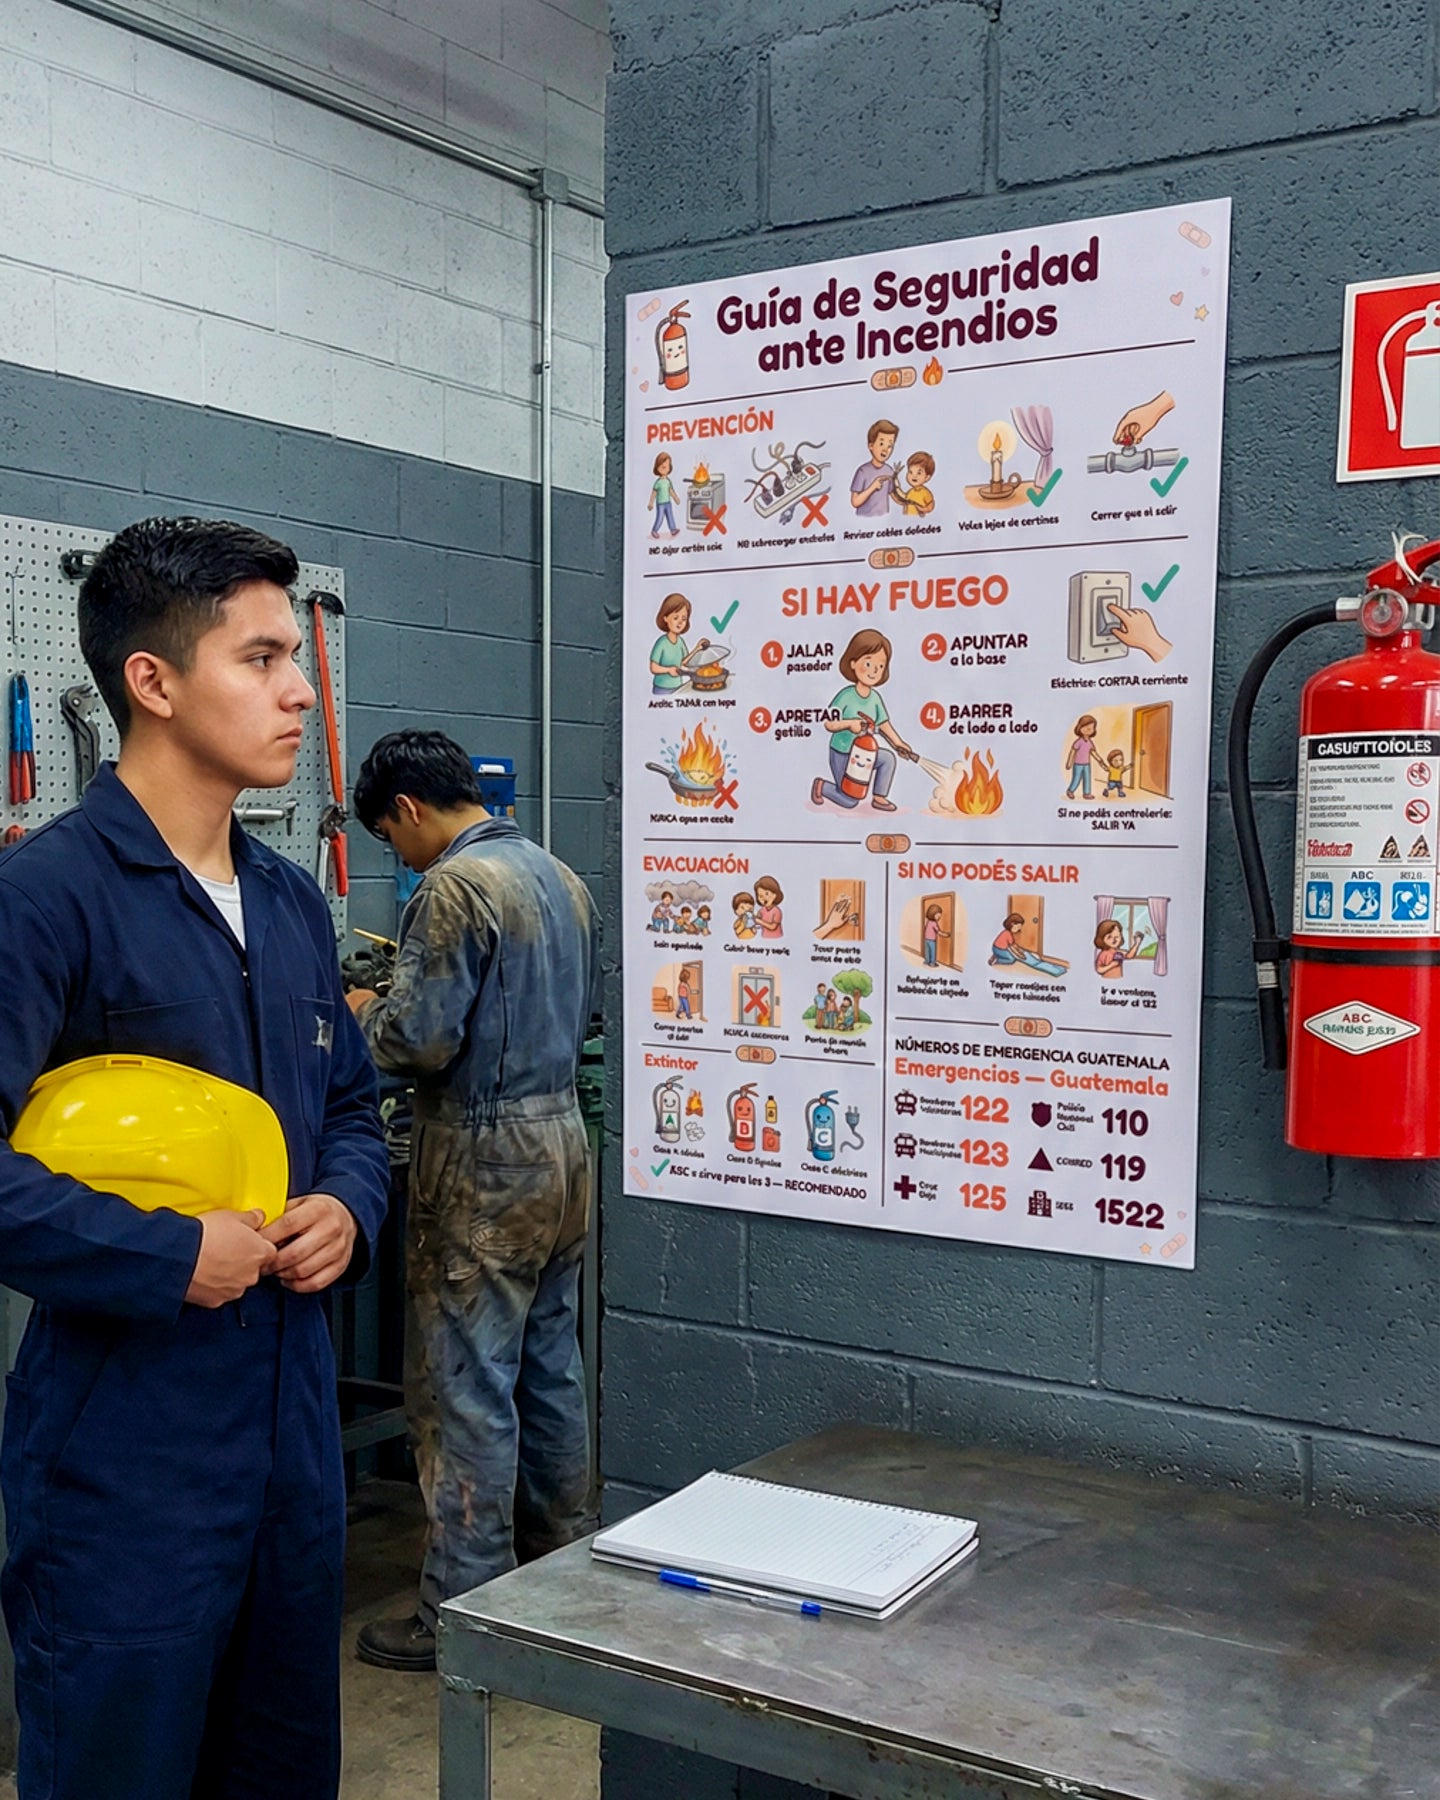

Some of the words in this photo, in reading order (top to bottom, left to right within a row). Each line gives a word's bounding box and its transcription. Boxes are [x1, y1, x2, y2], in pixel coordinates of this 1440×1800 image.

[716, 287, 802, 335] Guía
[812, 278, 862, 320] de
[873, 236, 1100, 315] Seguridad
[758, 330, 845, 373] ante
[855, 300, 1058, 360] Incendios
[646, 406, 774, 444] PREVENCIÓN
[1007, 517, 1020, 527] de
[781, 587, 808, 618] SI
[816, 582, 881, 615] HAY
[889, 574, 1009, 611] FUEGO
[767, 647, 779, 662] 1.
[786, 642, 834, 659] JALAR
[926, 639, 943, 656] 2.
[950, 633, 1028, 652] APUNTAR
[950, 656, 959, 666] a
[753, 711, 768, 728] 3.
[774, 708, 841, 724] APRETAR
[925, 706, 942, 723] 4.
[949, 703, 1013, 719] BARRER
[949, 721, 965, 735] de
[1091, 820, 1119, 830] SALIR
[1121, 820, 1136, 830] YA
[643, 853, 750, 874] EVACUACIÓN
[897, 862, 914, 878] SI
[918, 862, 947, 879] NO
[951, 859, 1017, 882] PODÉS
[1021, 865, 1079, 883] SALIR
[1351, 871, 1374, 880] ABC
[1342, 1013, 1372, 1023] ABC
[644, 1053, 699, 1071] Extintor
[895, 1037, 959, 1055] NÚMEROS
[963, 1043, 980, 1057] DE
[984, 1045, 1074, 1064] EMERGENCIA
[1050, 1069, 1169, 1097] Guatemala
[665, 1113, 675, 1125] A
[960, 1094, 1010, 1124] 122
[1101, 1108, 1149, 1137] 110
[817, 1131, 829, 1143] C
[959, 1138, 1010, 1168] 123
[1100, 1153, 1146, 1182] 119
[959, 1182, 1007, 1212] 125
[1094, 1197, 1165, 1230] 1522
